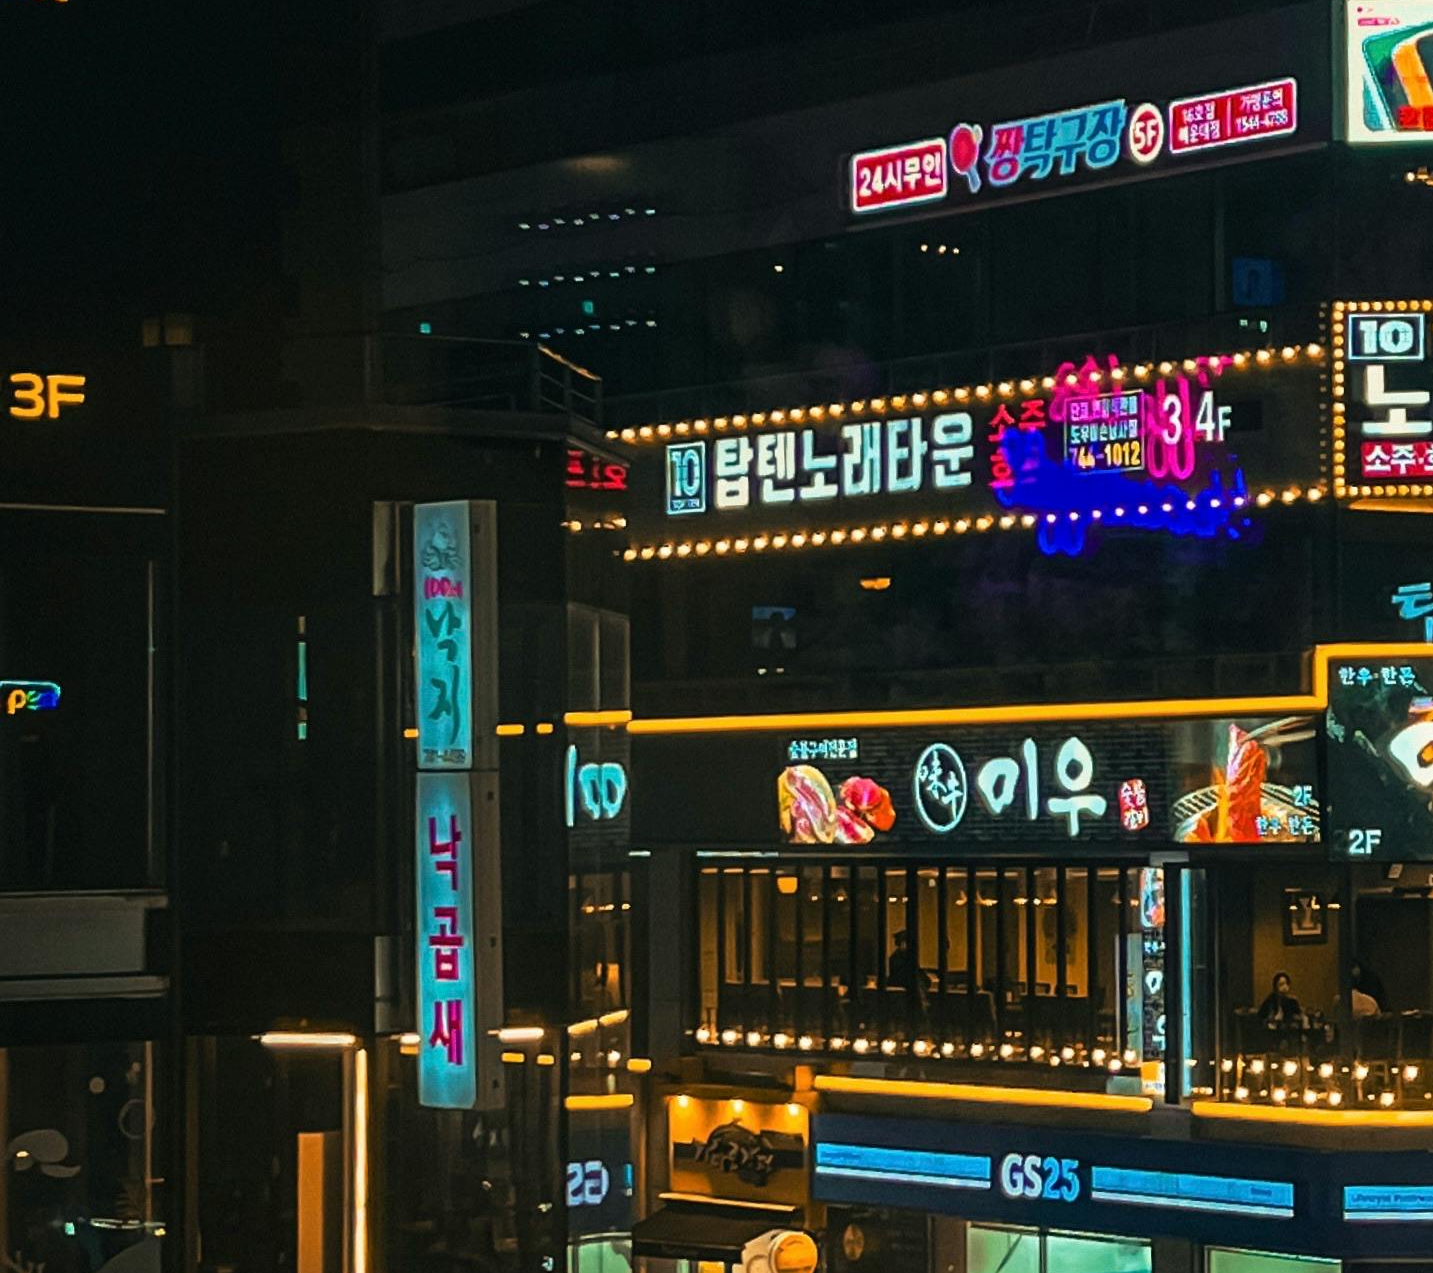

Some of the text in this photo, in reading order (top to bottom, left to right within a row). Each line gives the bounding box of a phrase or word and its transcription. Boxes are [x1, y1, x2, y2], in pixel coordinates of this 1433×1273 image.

[988, 102, 1125, 183] 짱탁구장
[1132, 118, 1159, 148] 5F
[859, 146, 943, 197] 24시무인
[1359, 320, 1414, 354] 10
[10, 372, 87, 421] 3F
[670, 448, 700, 498] 10
[713, 411, 973, 509] 탑텐노래타운
[425, 599, 463, 746] 낙지
[977, 736, 1108, 837] 미우
[1347, 829, 1382, 855] 2F
[427, 813, 465, 1067] 낙곱새
[1001, 1153, 1081, 1203] GS25
